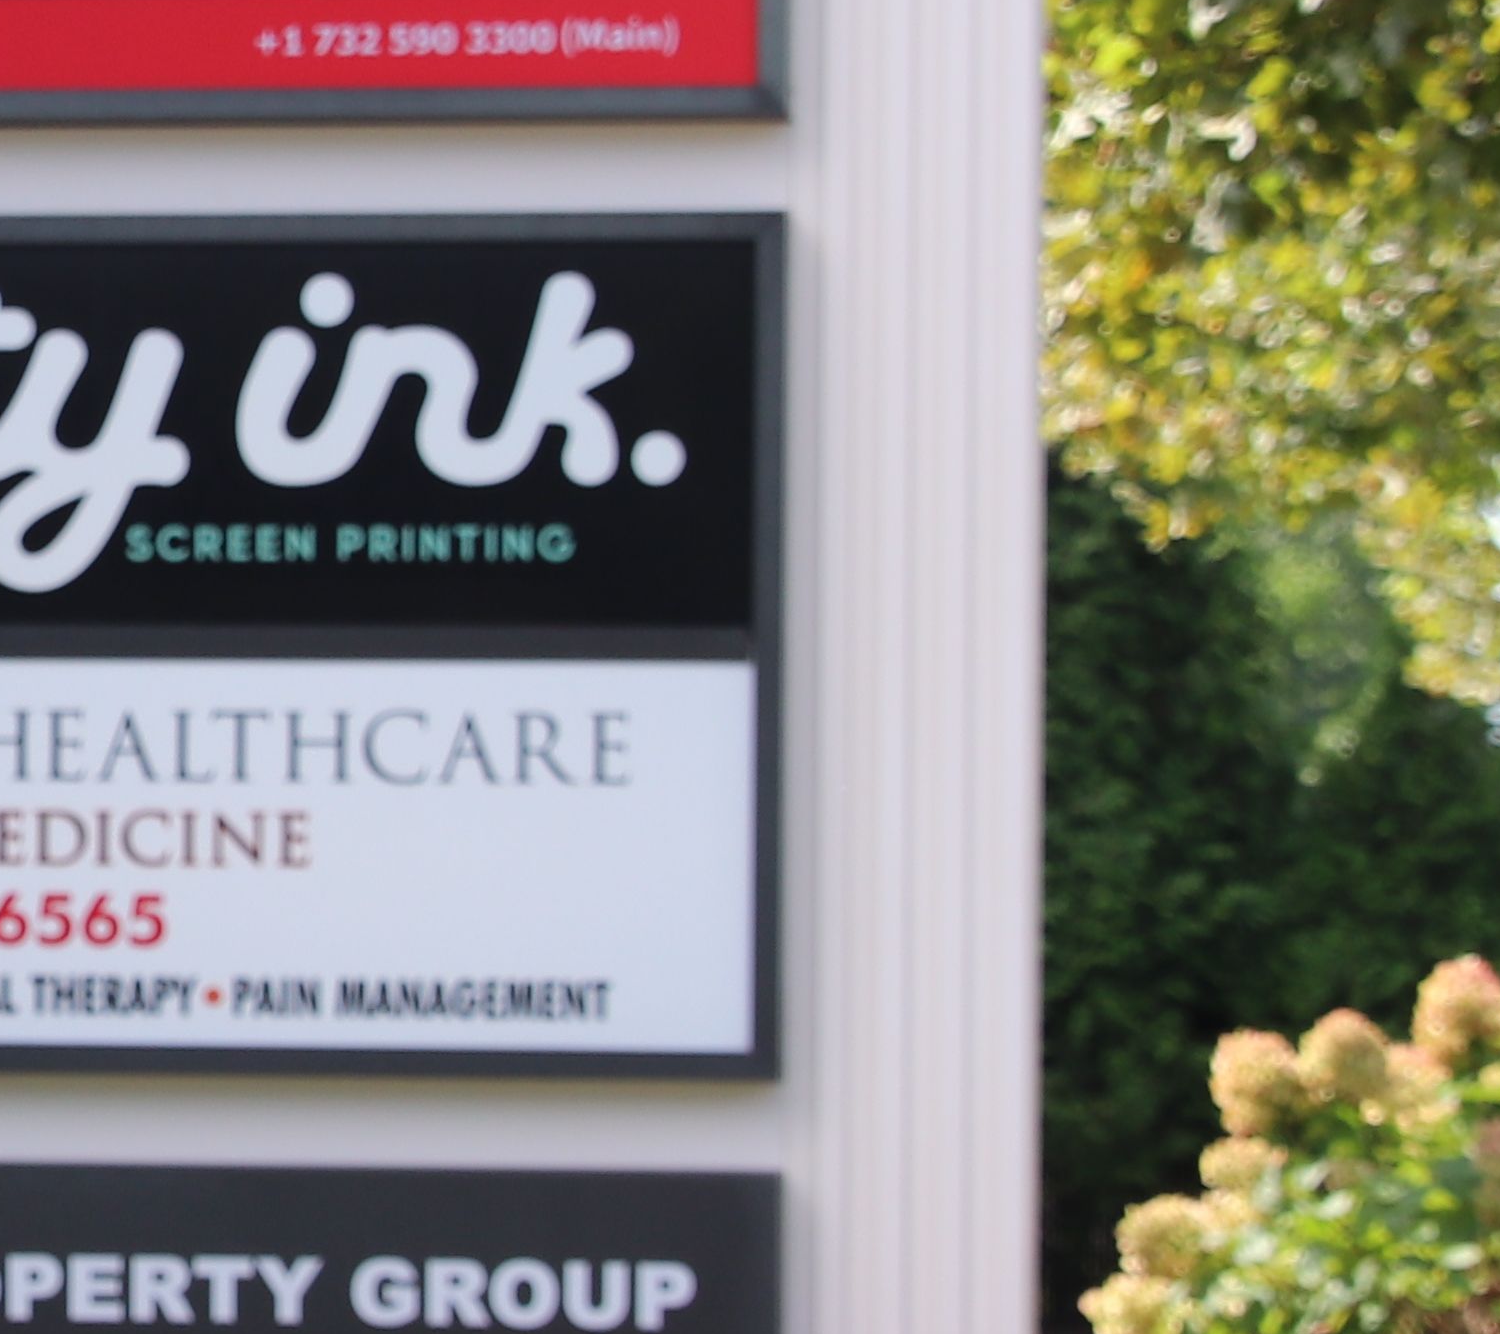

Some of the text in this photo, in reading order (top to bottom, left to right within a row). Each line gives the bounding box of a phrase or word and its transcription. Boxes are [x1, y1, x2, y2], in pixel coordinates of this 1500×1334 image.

[254, 22, 303, 58] +1
[312, 20, 382, 57] 732
[560, 14, 680, 59] (Main)
[234, 270, 689, 489] ink.
[125, 524, 316, 562] SCREEN
[336, 524, 577, 562] PRINTING
[31, 974, 199, 1017] THERAPY
[232, 977, 320, 1018] PAIN
[334, 978, 612, 1021] MANAGEMENT
[349, 1258, 696, 1333] GROUP
